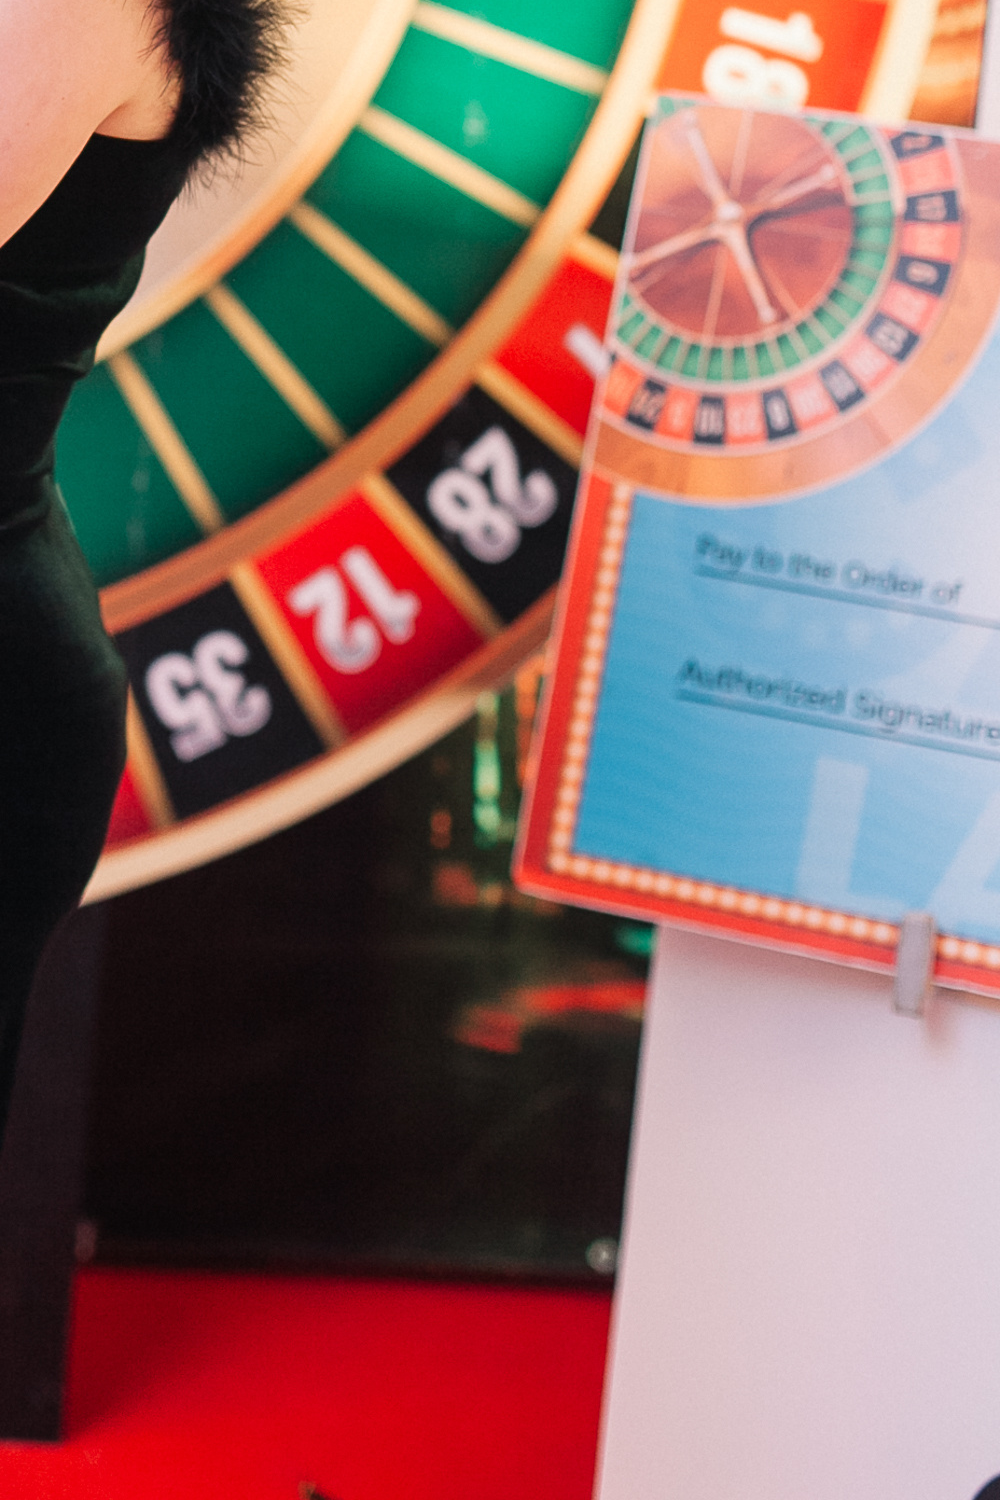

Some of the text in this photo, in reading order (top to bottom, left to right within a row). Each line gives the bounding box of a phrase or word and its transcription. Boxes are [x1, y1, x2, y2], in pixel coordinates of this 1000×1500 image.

[702, 6, 823, 113] 18
[427, 426, 557, 564] 28
[287, 546, 419, 674] 12
[695, 531, 964, 605] Pay to the Order of
[145, 630, 271, 762] 35
[677, 657, 848, 714] Authorized
